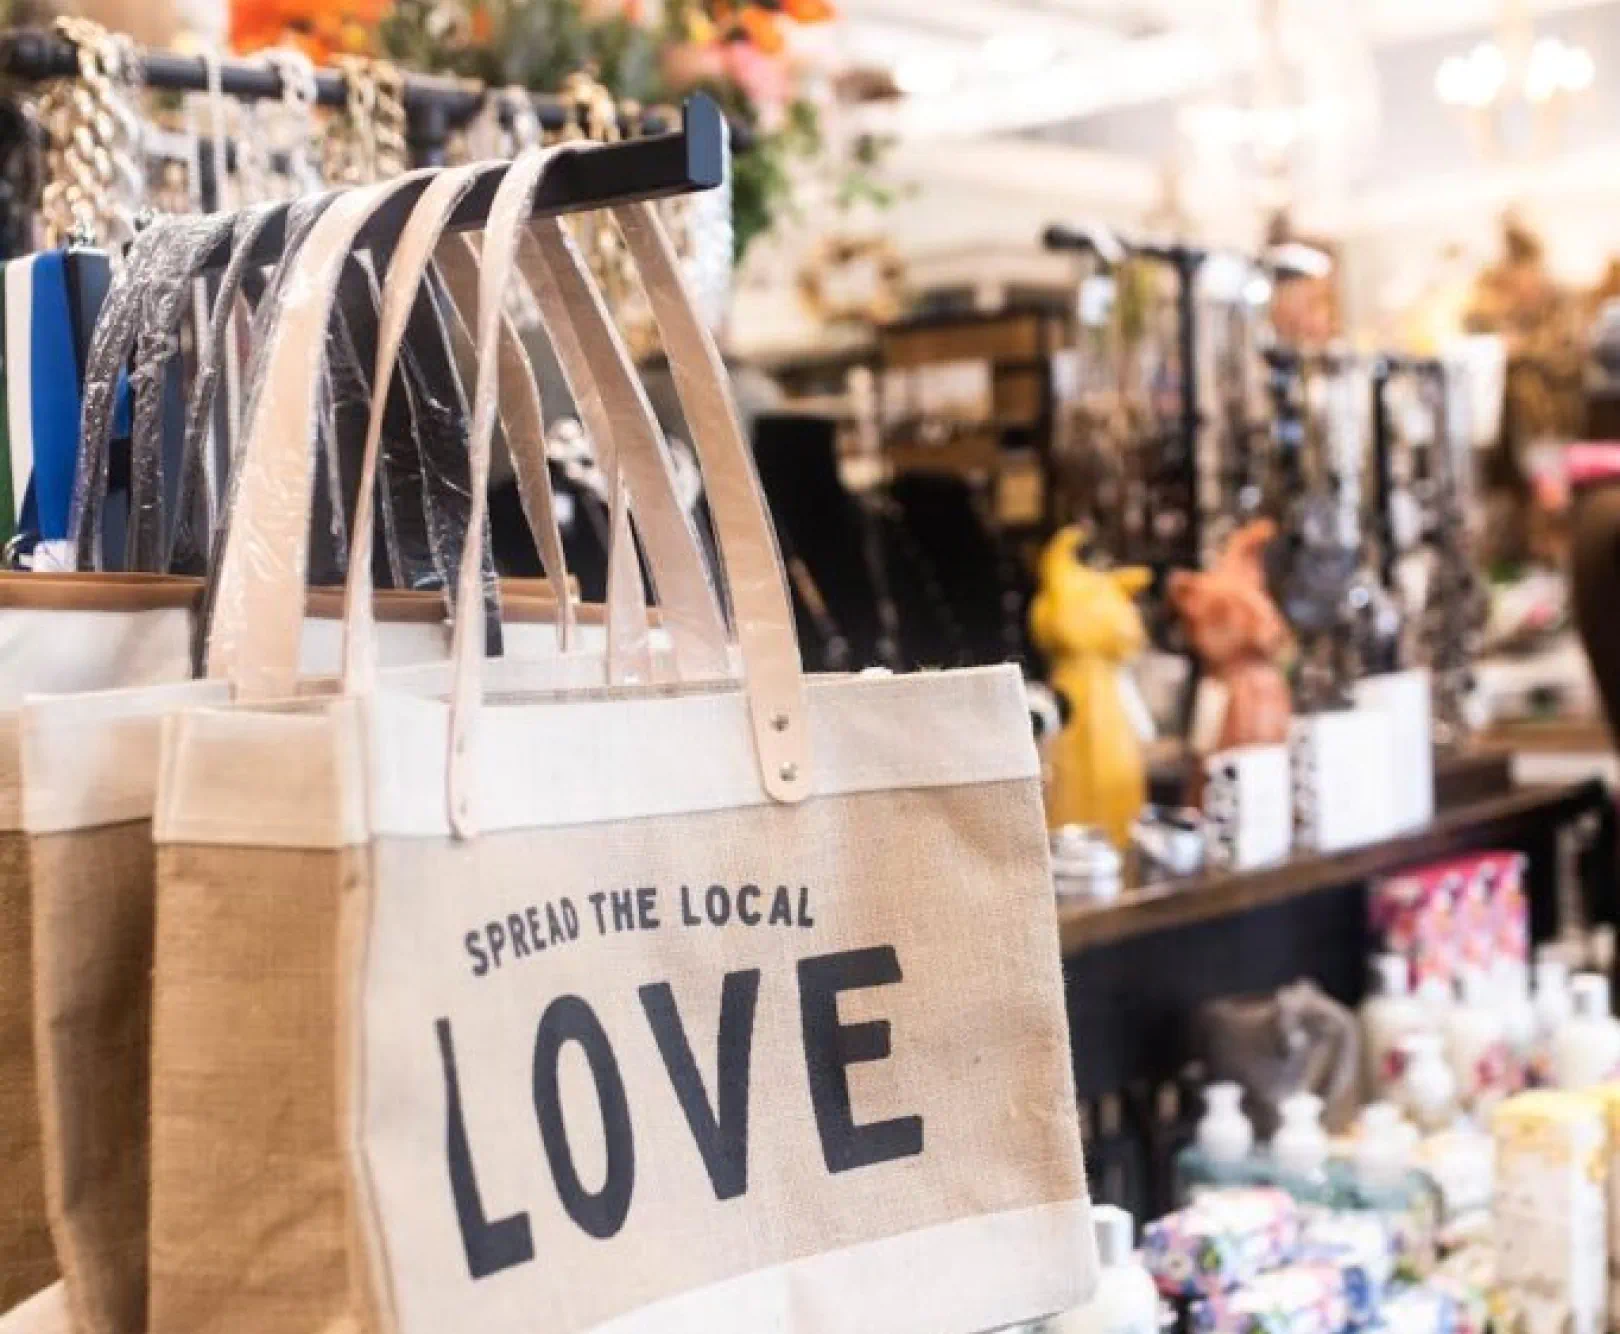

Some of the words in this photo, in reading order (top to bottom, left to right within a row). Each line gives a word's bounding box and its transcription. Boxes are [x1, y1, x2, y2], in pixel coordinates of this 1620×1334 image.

[464, 897, 579, 976] SPREAD
[589, 887, 660, 933] THE
[681, 884, 815, 928] LOCAL
[435, 944, 924, 1279] LOVE
